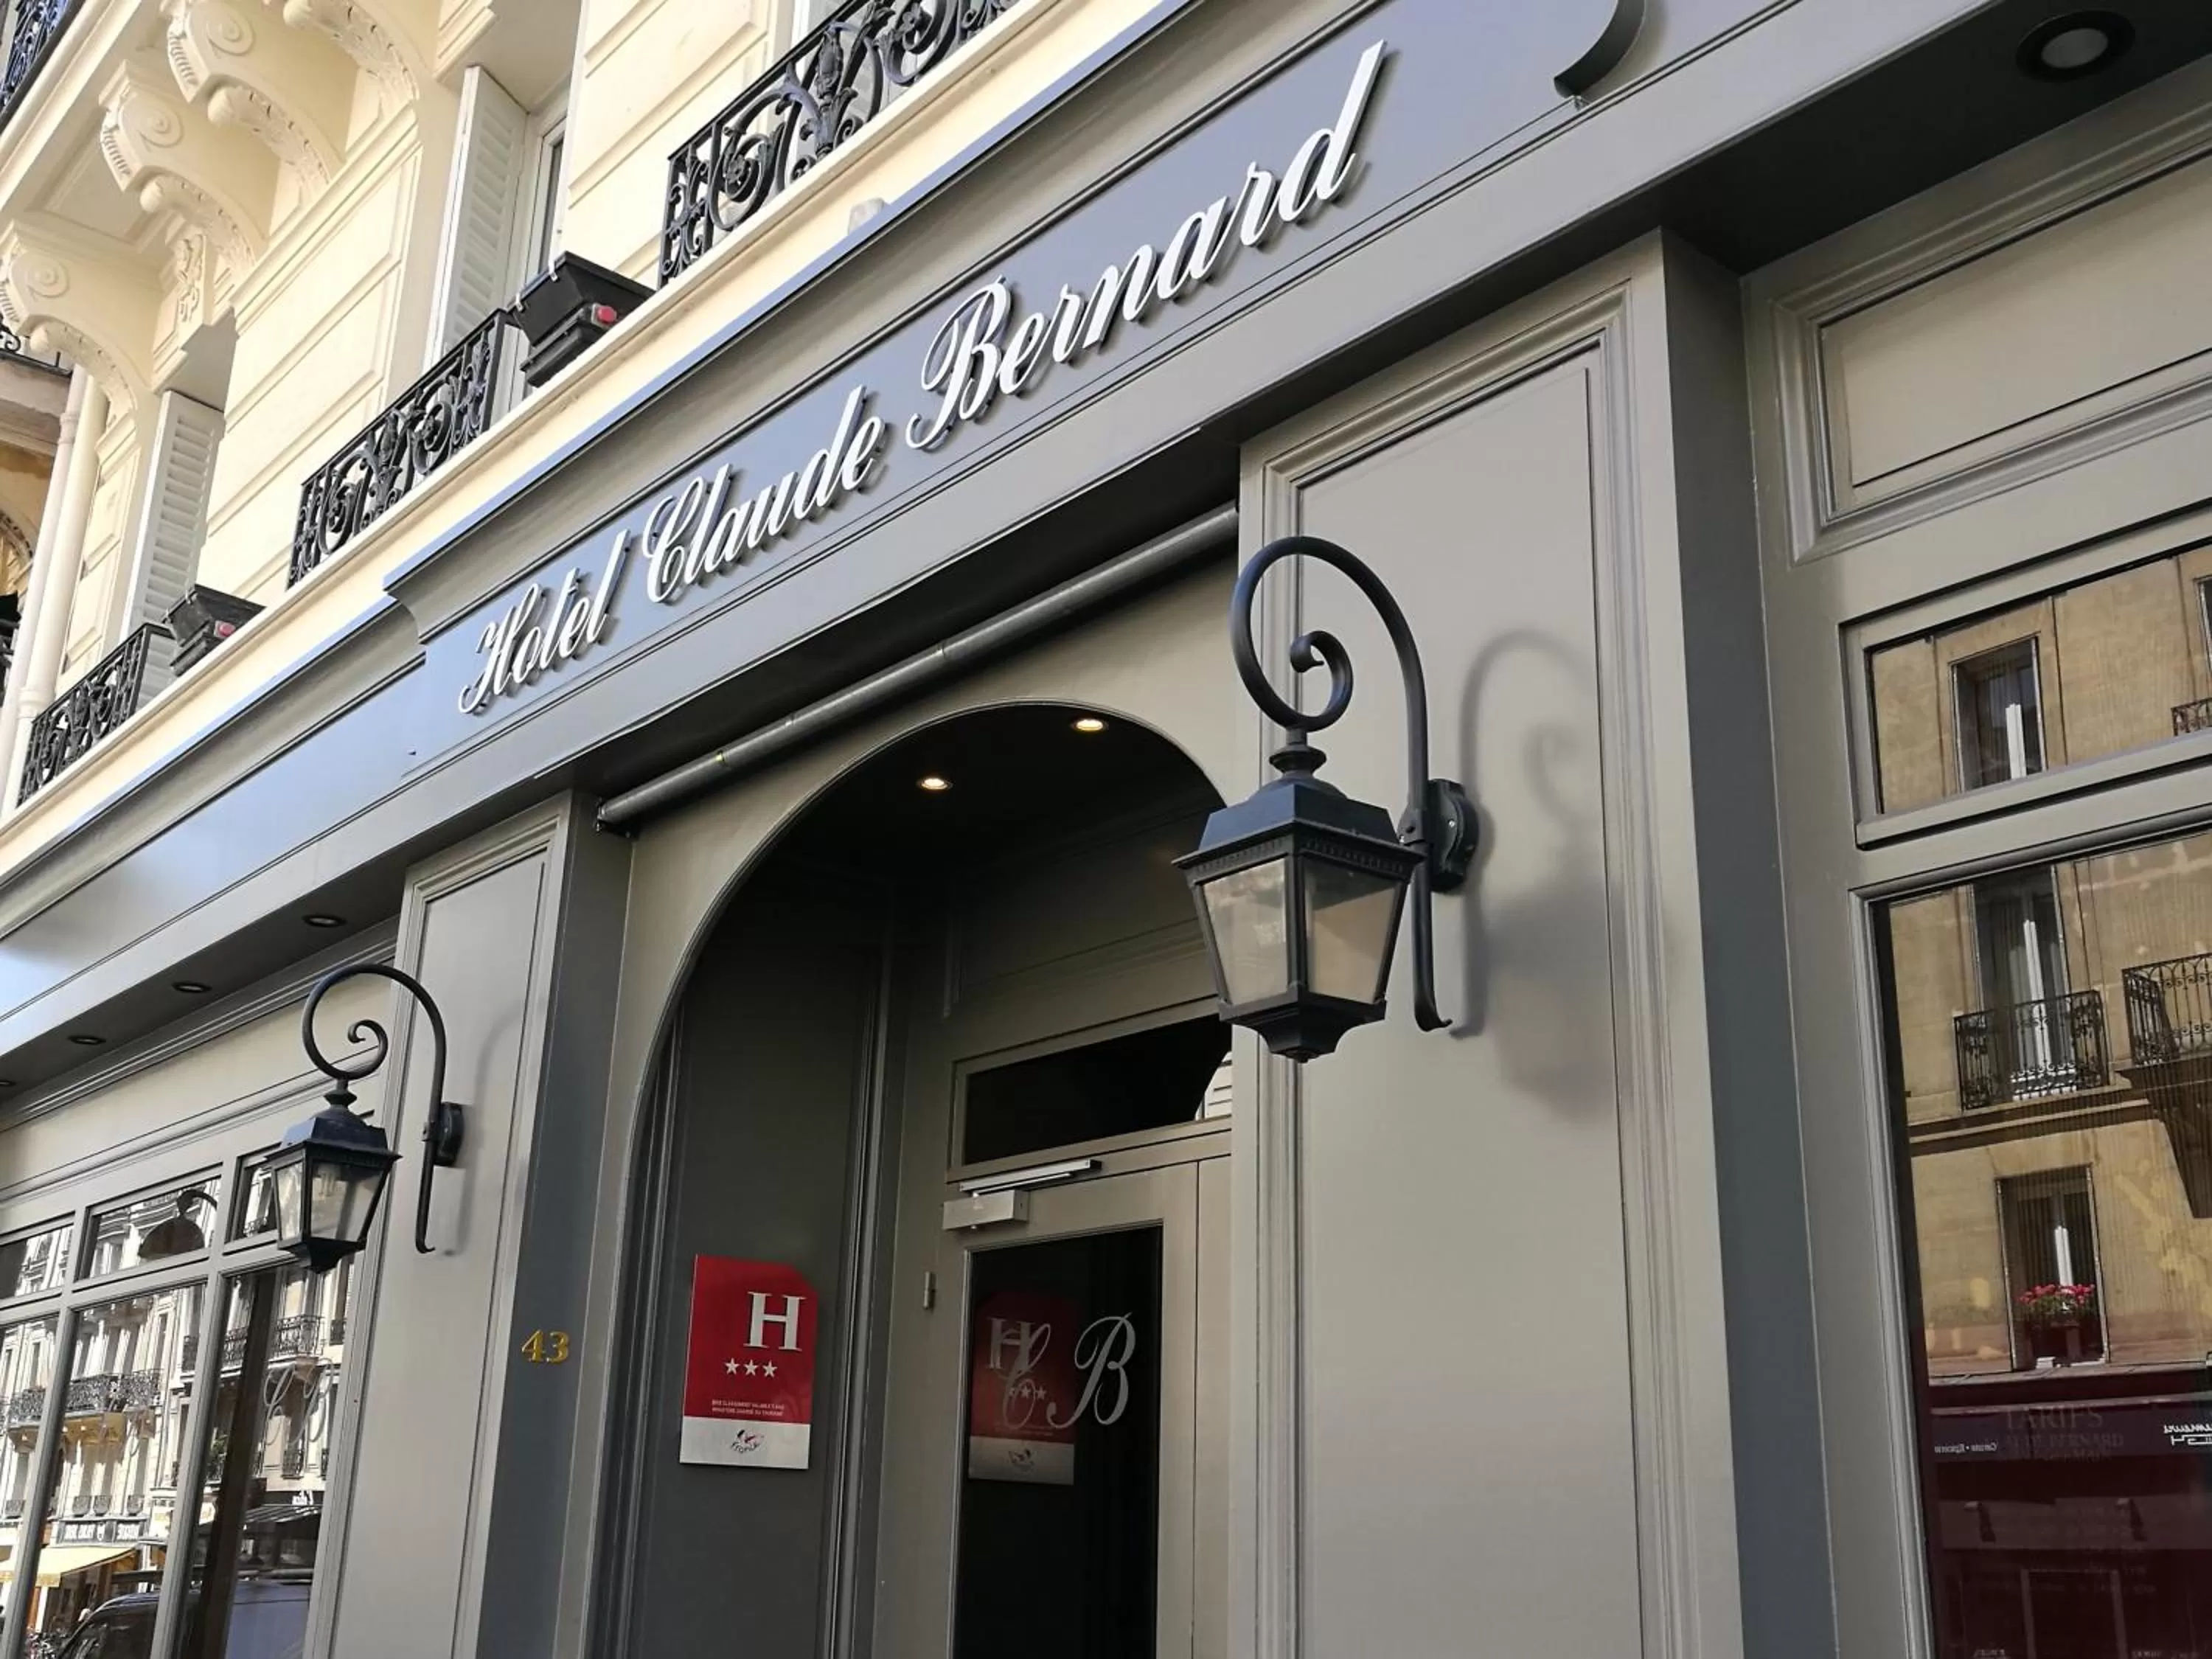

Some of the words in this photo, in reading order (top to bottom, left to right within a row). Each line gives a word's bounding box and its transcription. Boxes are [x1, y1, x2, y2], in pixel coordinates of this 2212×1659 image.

[458, 528, 632, 716] Hotel
[640, 384, 884, 605] Claude
[905, 38, 1388, 450] Bernard
[521, 1329, 568, 1365] 43
[742, 1290, 807, 1352] H
